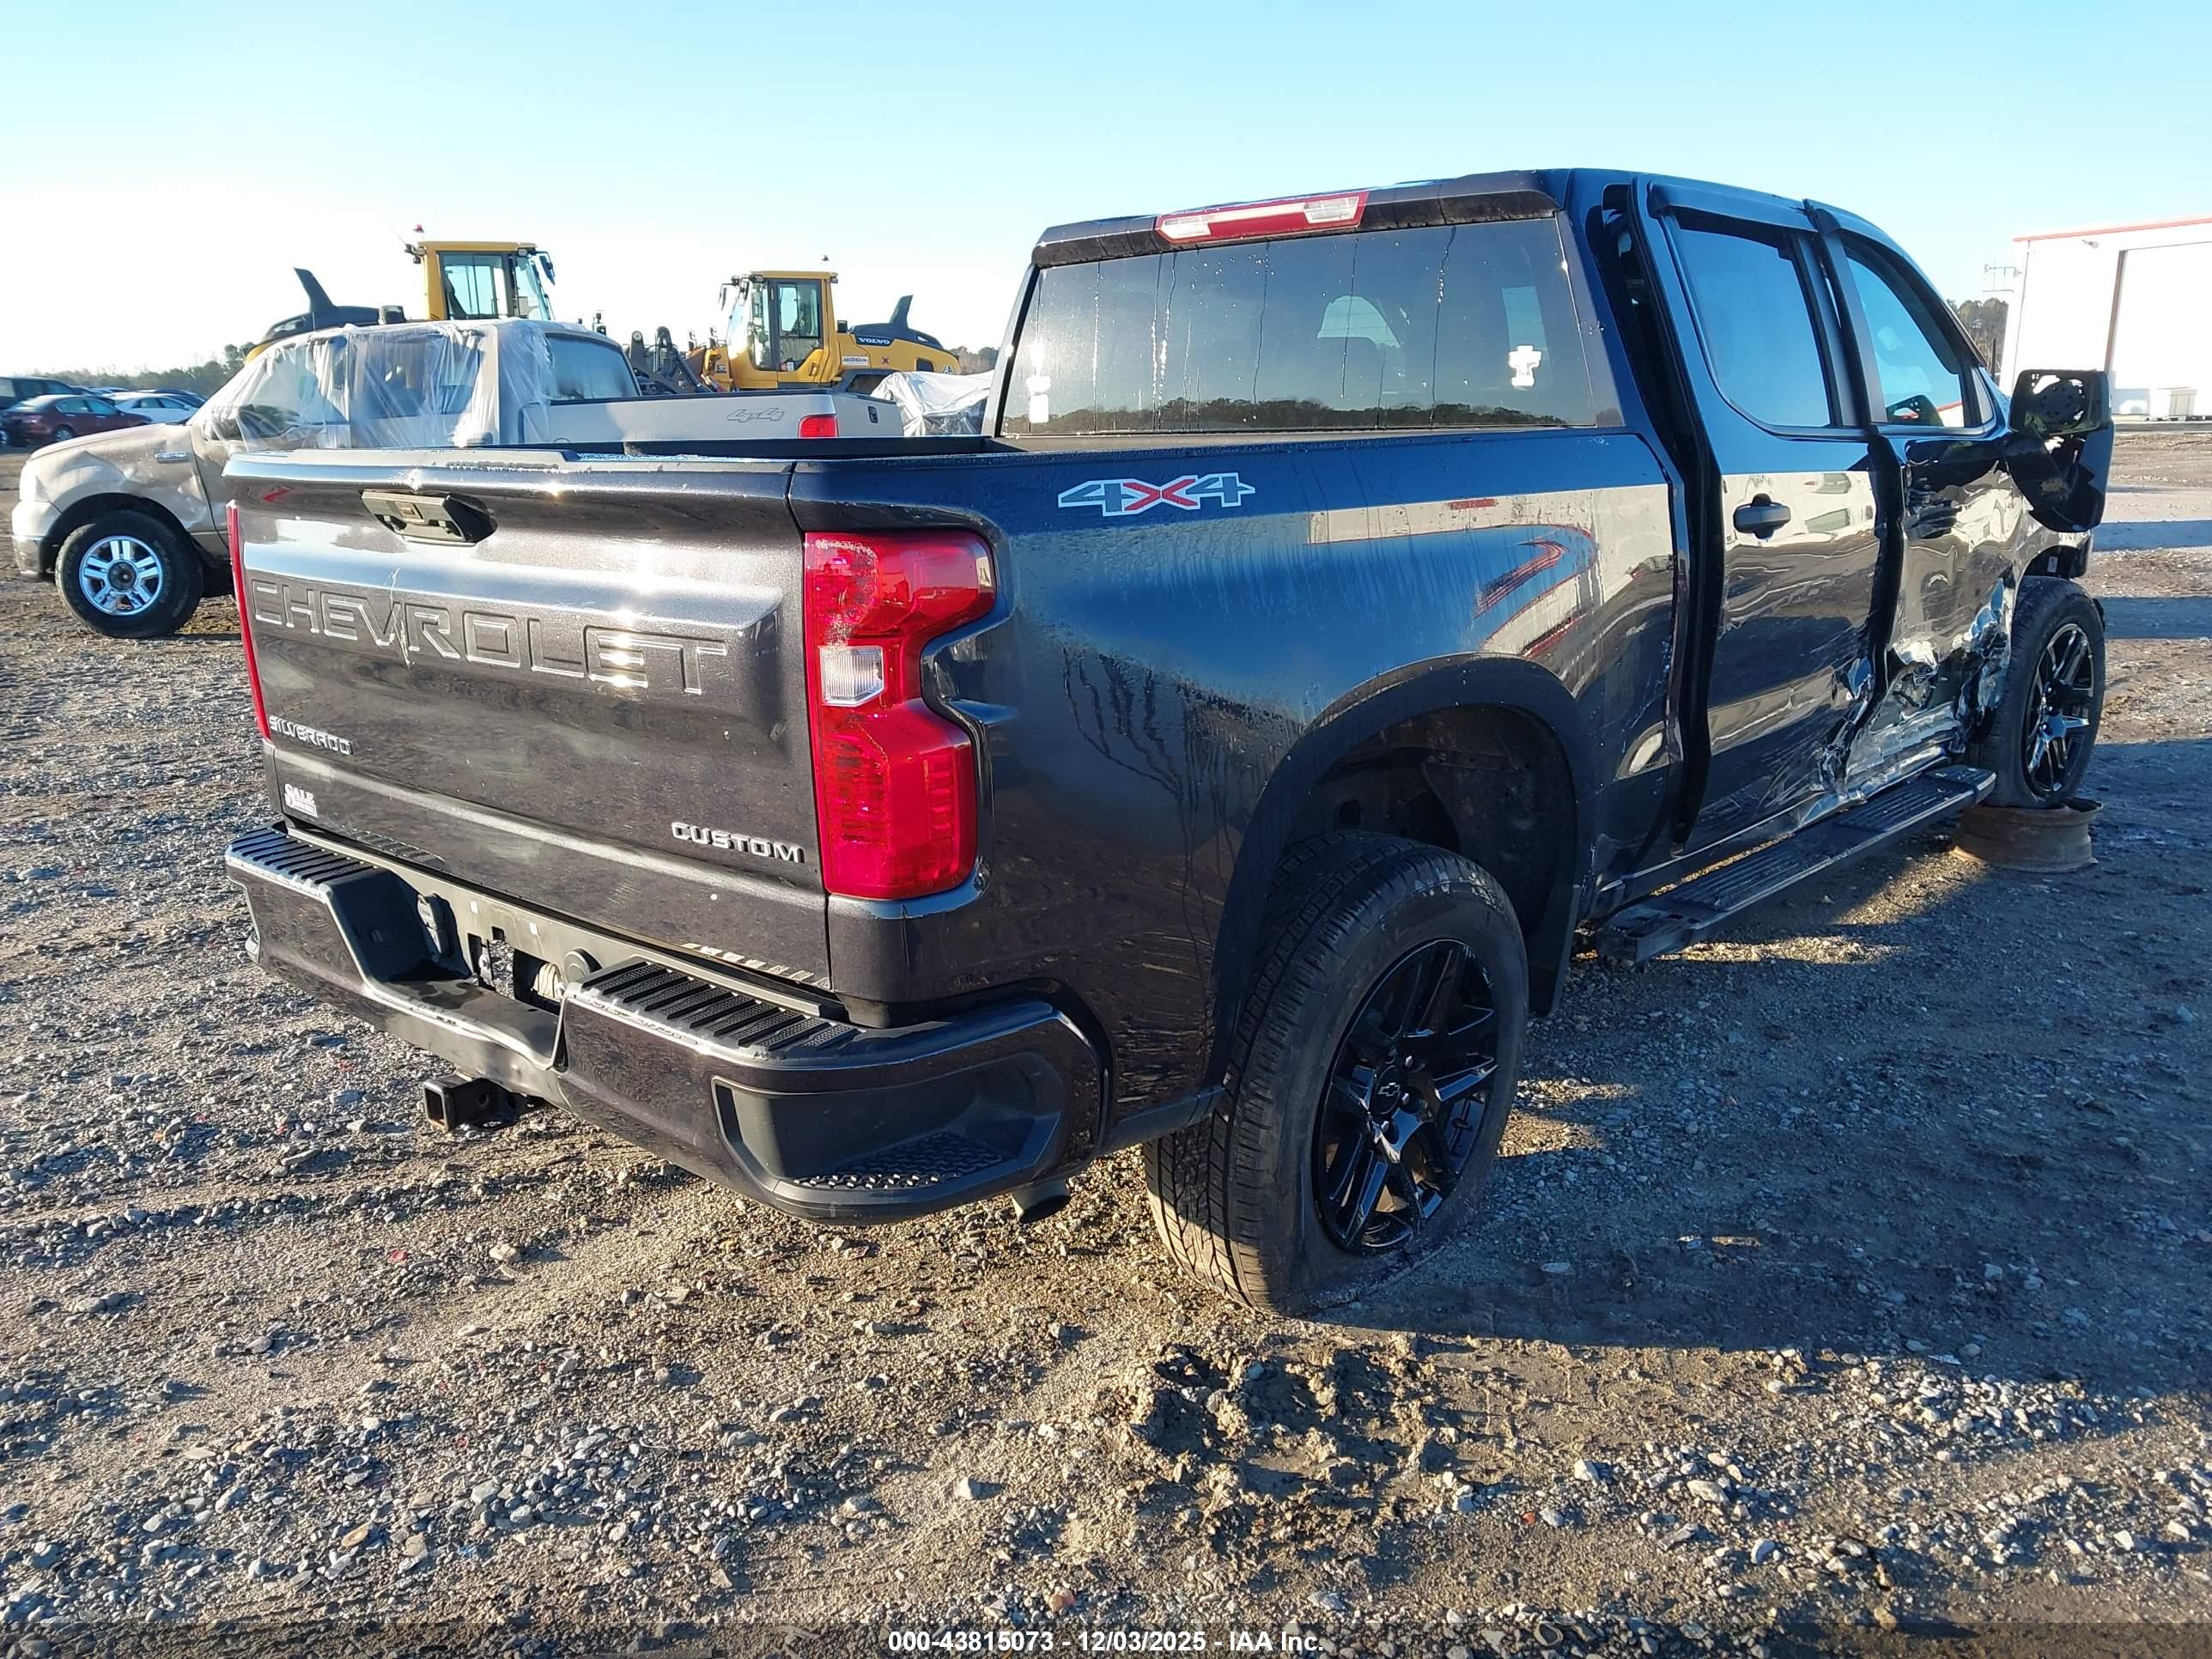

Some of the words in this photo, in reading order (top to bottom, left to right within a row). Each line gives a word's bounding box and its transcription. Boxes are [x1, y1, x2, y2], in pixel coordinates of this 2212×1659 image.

[252, 579, 726, 695] CHEVROLET
[269, 714, 353, 755] SILVERADO
[672, 822, 805, 863] CUSTOM
